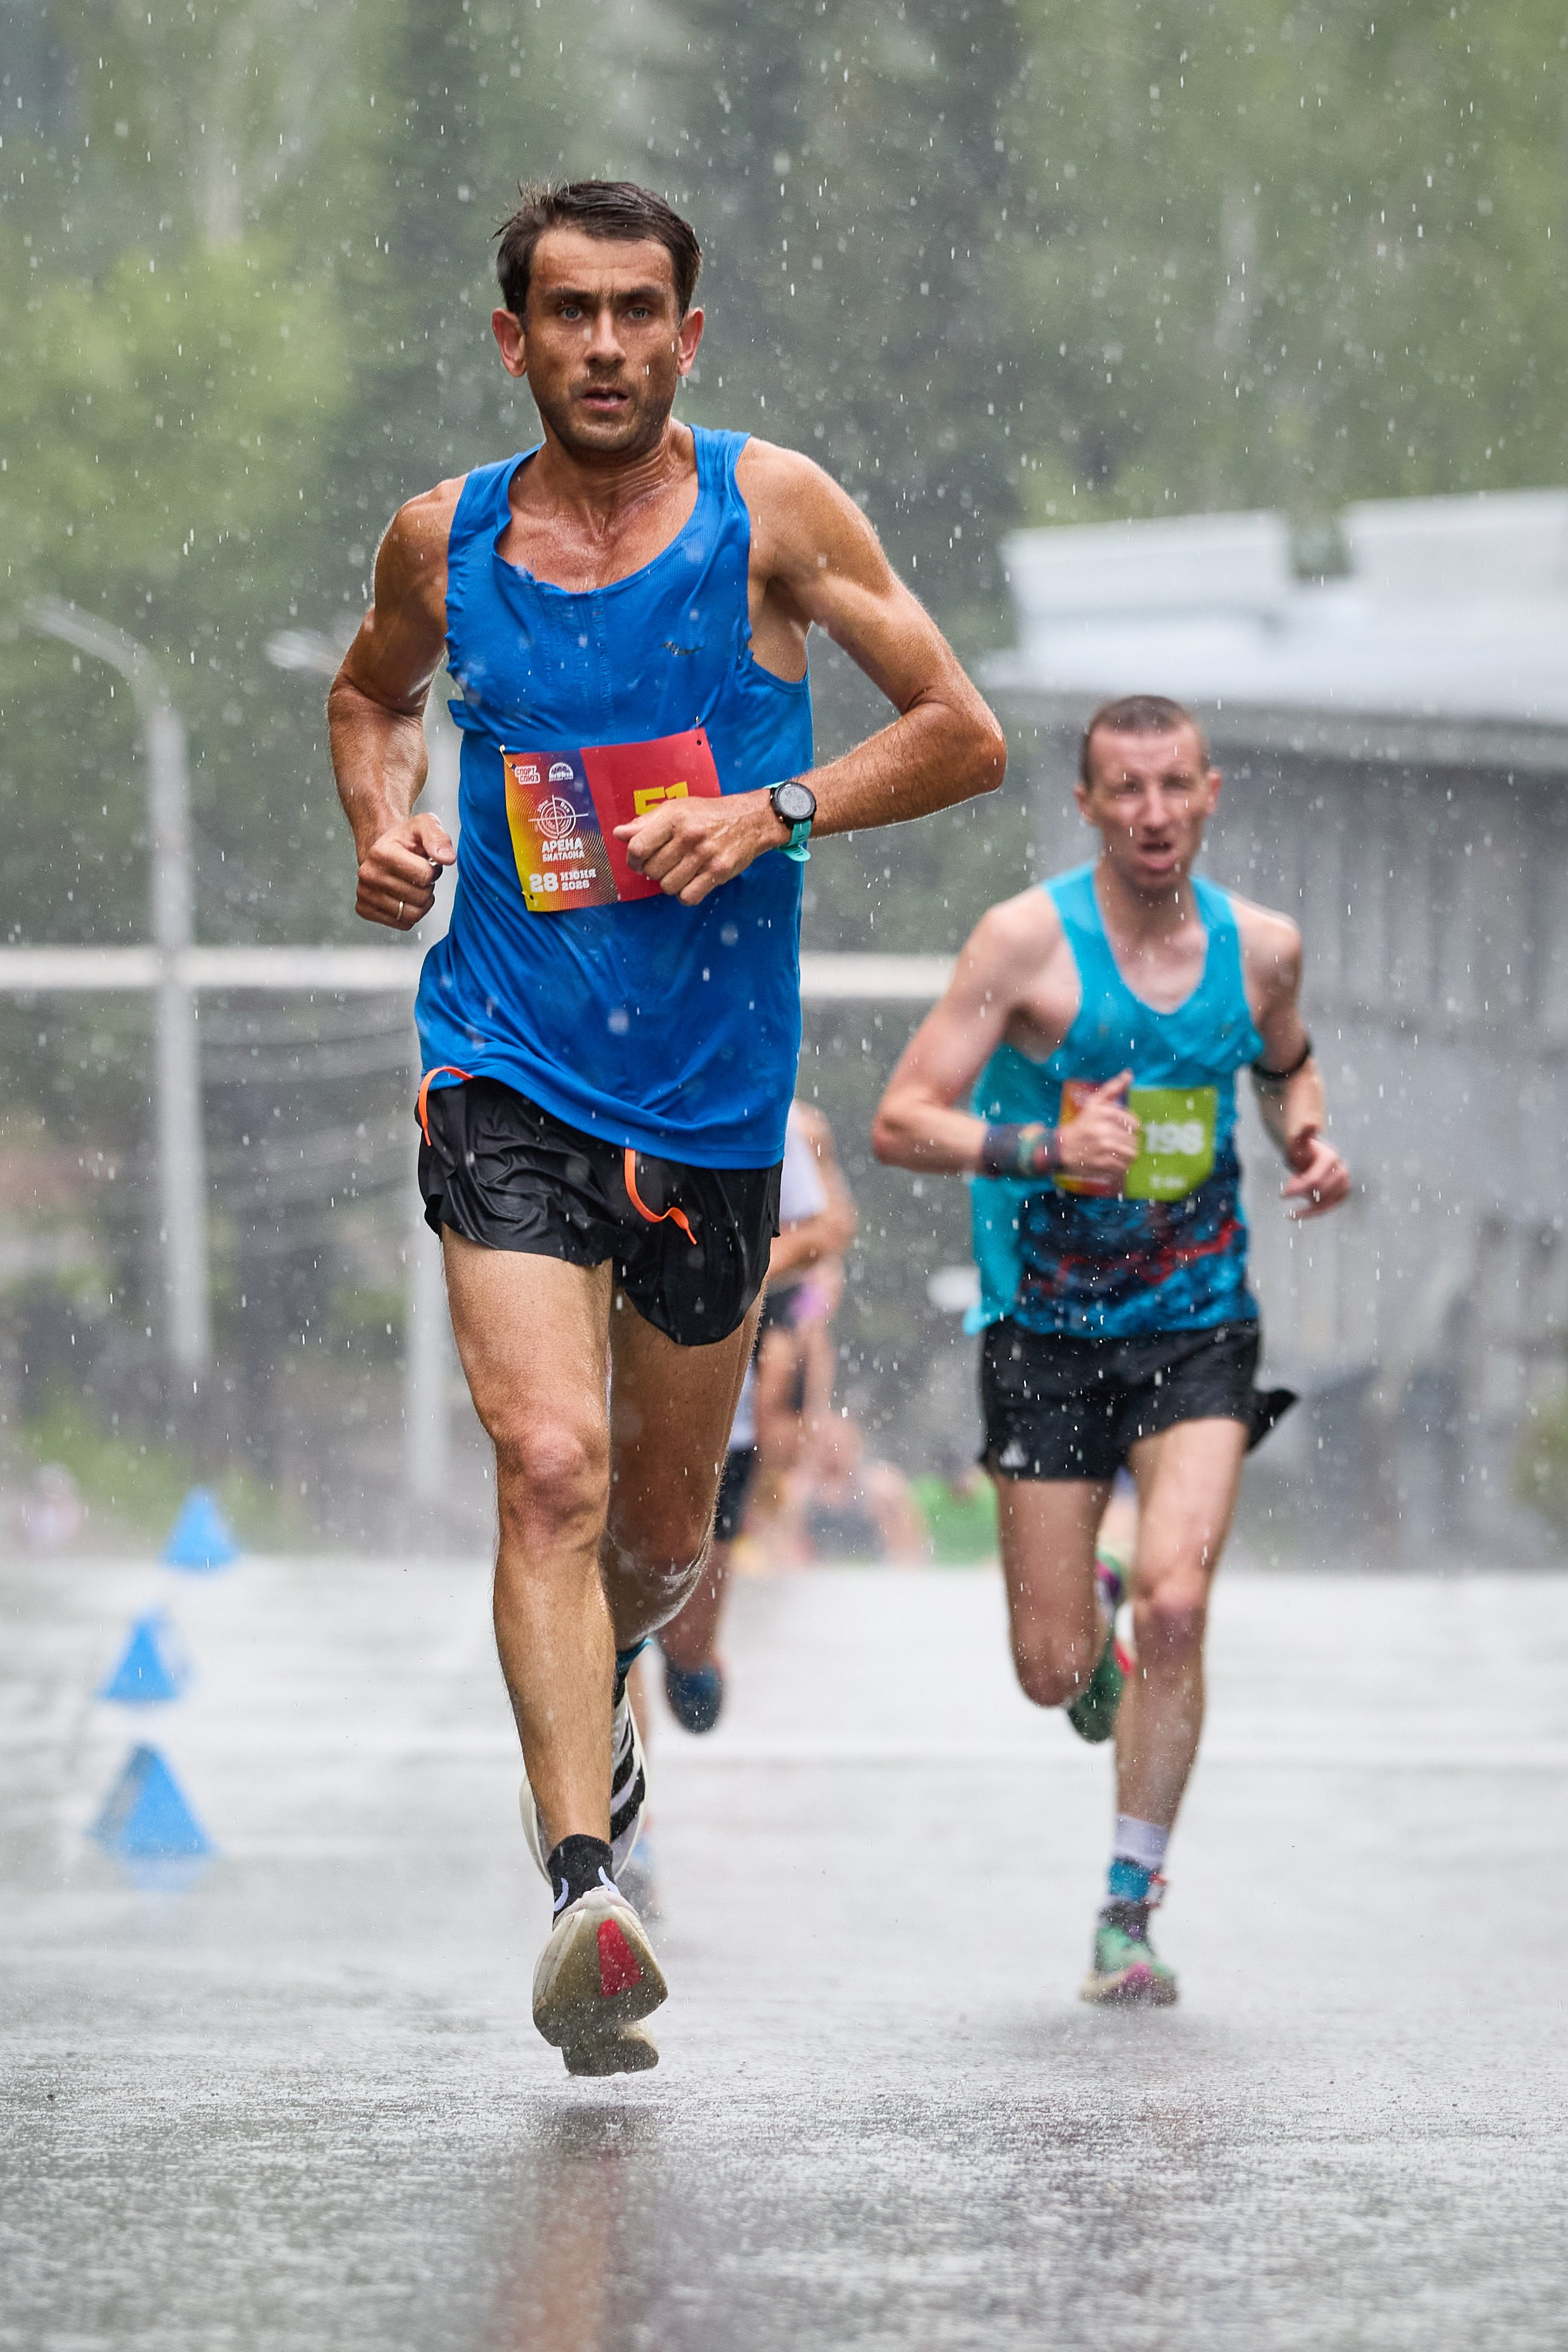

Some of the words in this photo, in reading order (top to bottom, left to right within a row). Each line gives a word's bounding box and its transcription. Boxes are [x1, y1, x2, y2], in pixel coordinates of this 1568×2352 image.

[516, 767, 535, 776] СПОРТ
[520, 774, 538, 783] СОЮЗ
[541, 837, 583, 854] АРЕНА
[542, 850, 585, 862] БИАТЛОНА
[529, 872, 559, 893] 28
[560, 868, 597, 881] ИЮНЯ
[562, 880, 590, 891] 2026
